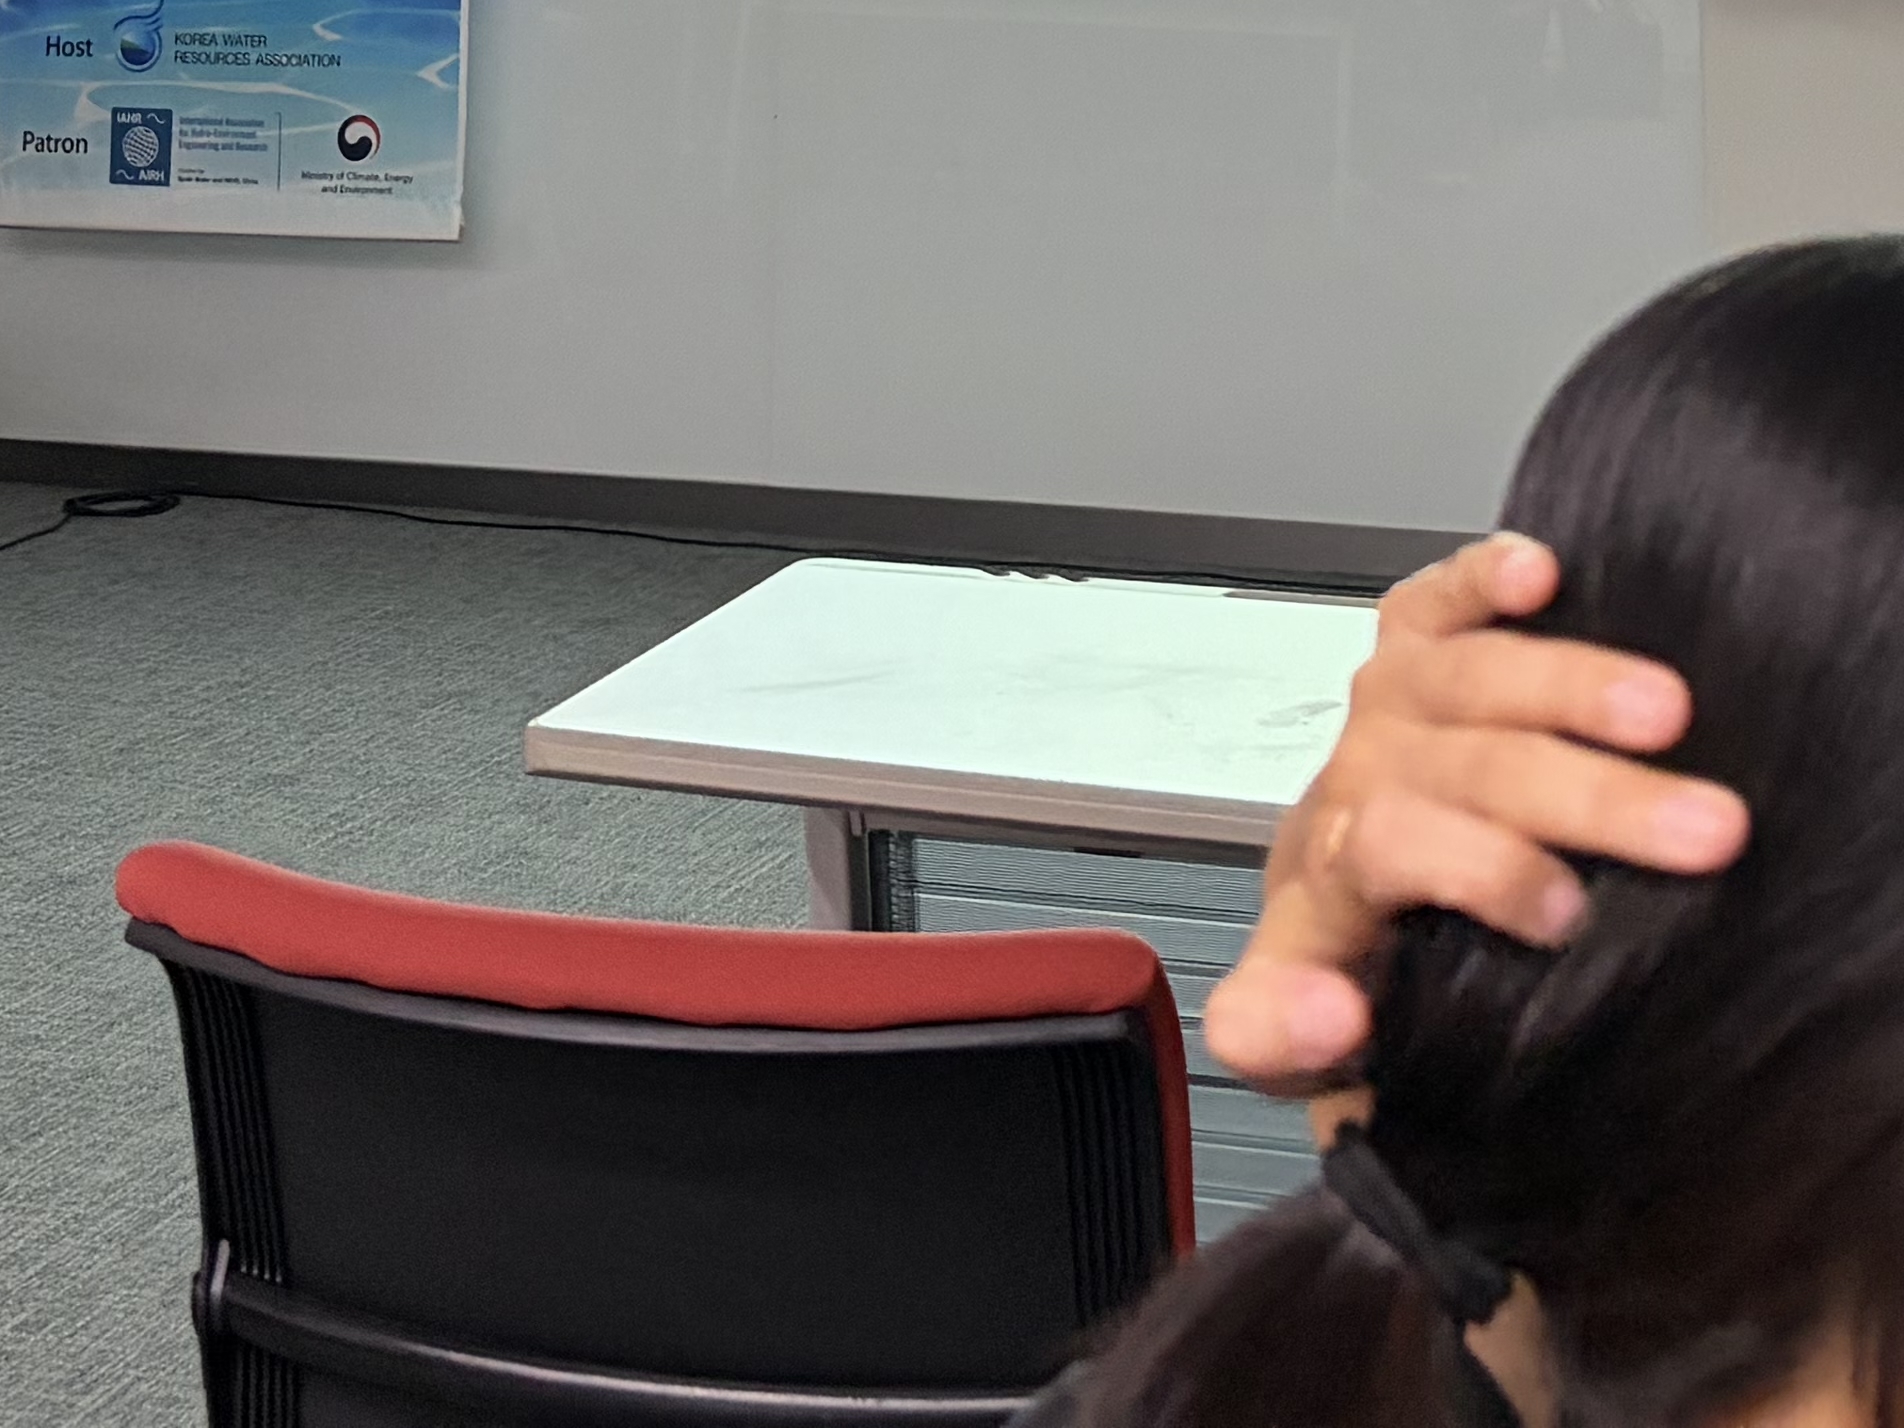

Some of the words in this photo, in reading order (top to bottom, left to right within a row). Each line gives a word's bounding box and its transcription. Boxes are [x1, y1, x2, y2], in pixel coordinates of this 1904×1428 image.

[46, 36, 93, 58] Host
[175, 33, 218, 46] KOREA
[222, 34, 267, 48] WATER
[174, 50, 250, 66] RESOURCES
[256, 53, 341, 67] ASSOCIATION
[22, 131, 88, 154] Patron
